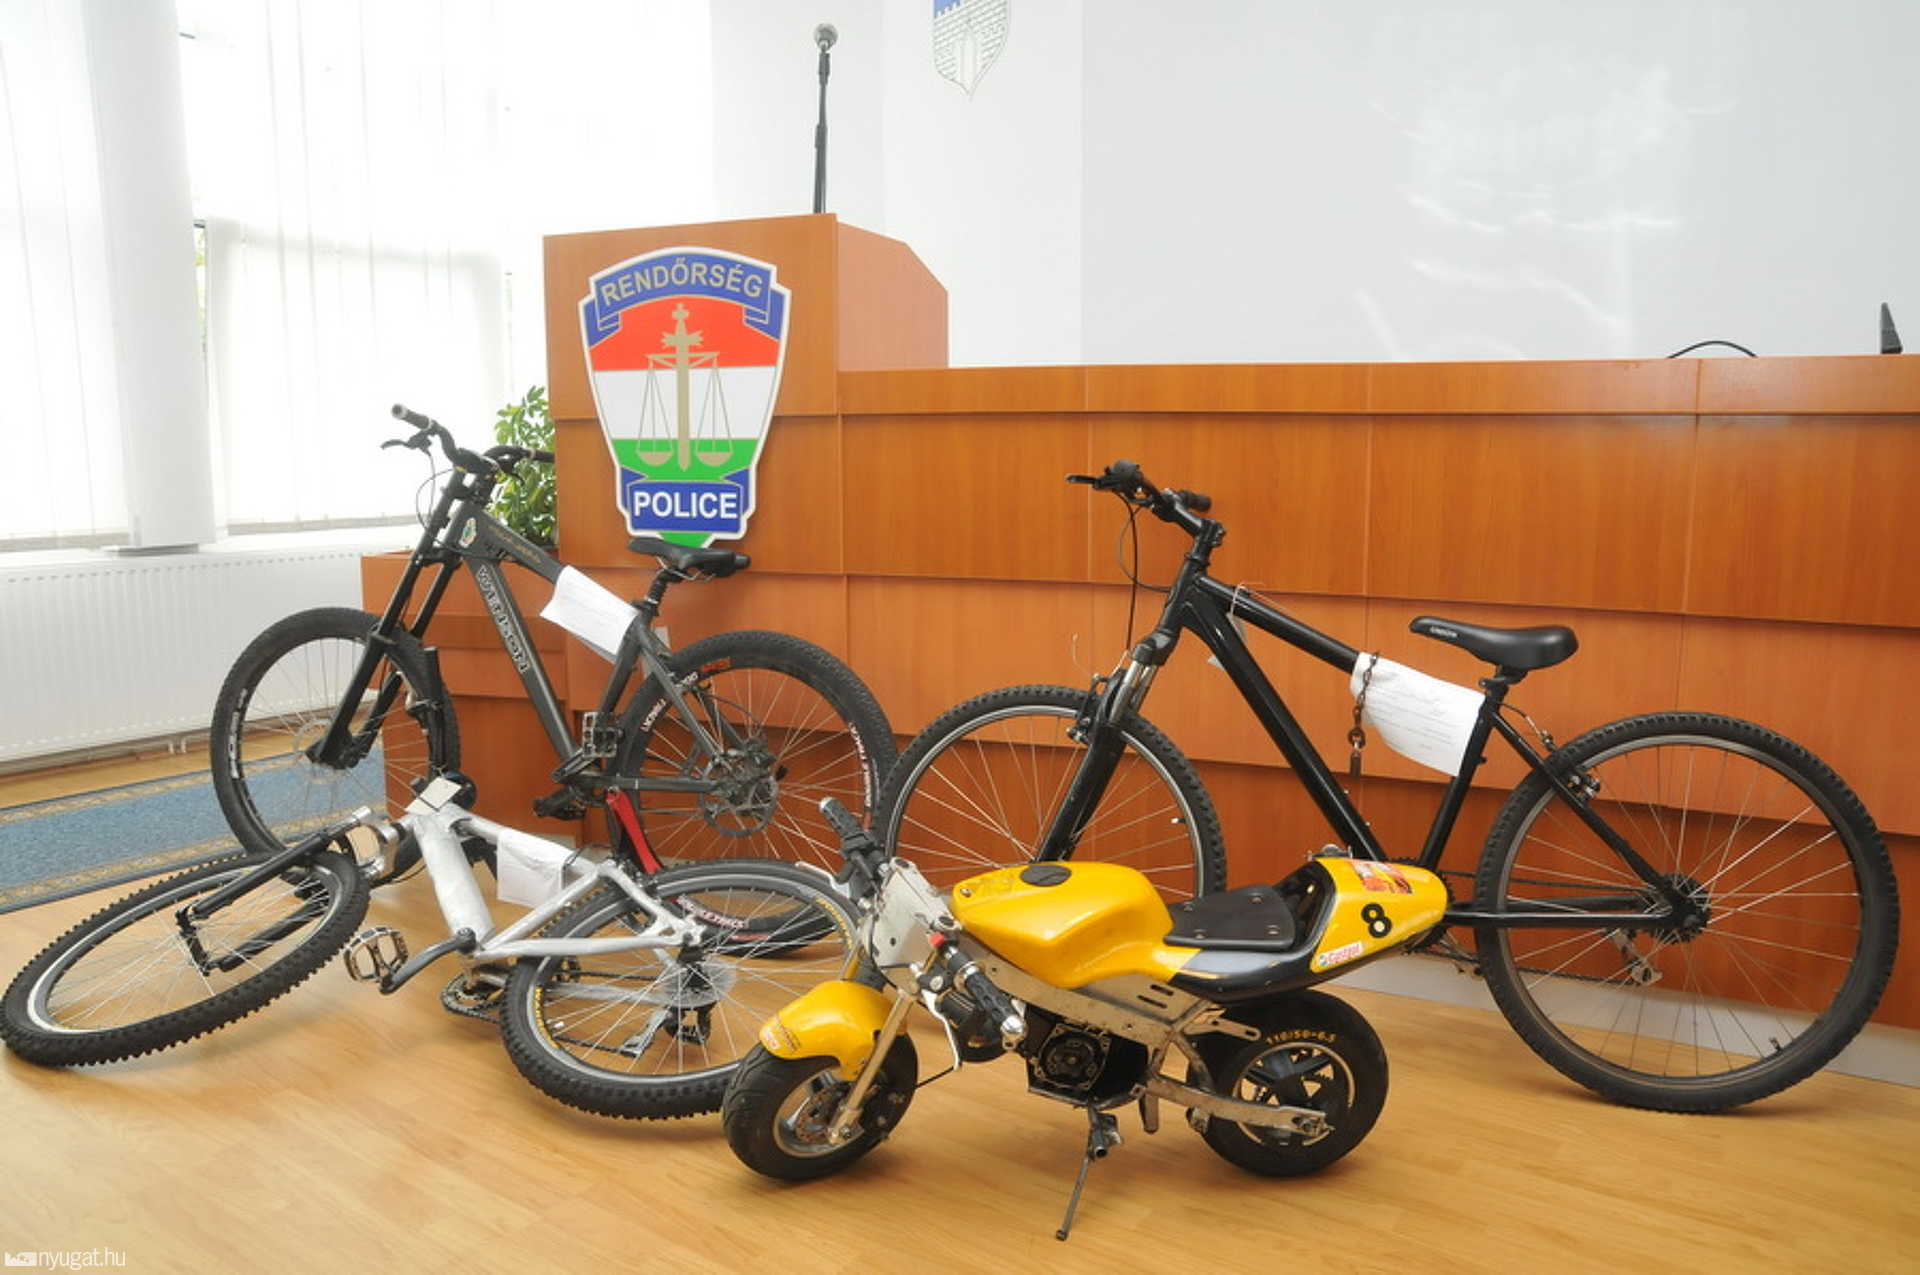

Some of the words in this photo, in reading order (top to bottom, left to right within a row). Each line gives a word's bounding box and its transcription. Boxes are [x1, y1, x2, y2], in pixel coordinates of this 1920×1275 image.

[601, 257, 763, 306] RENDŐRSÉG
[633, 491, 738, 519] POLICE
[1361, 902, 1393, 938] 8
